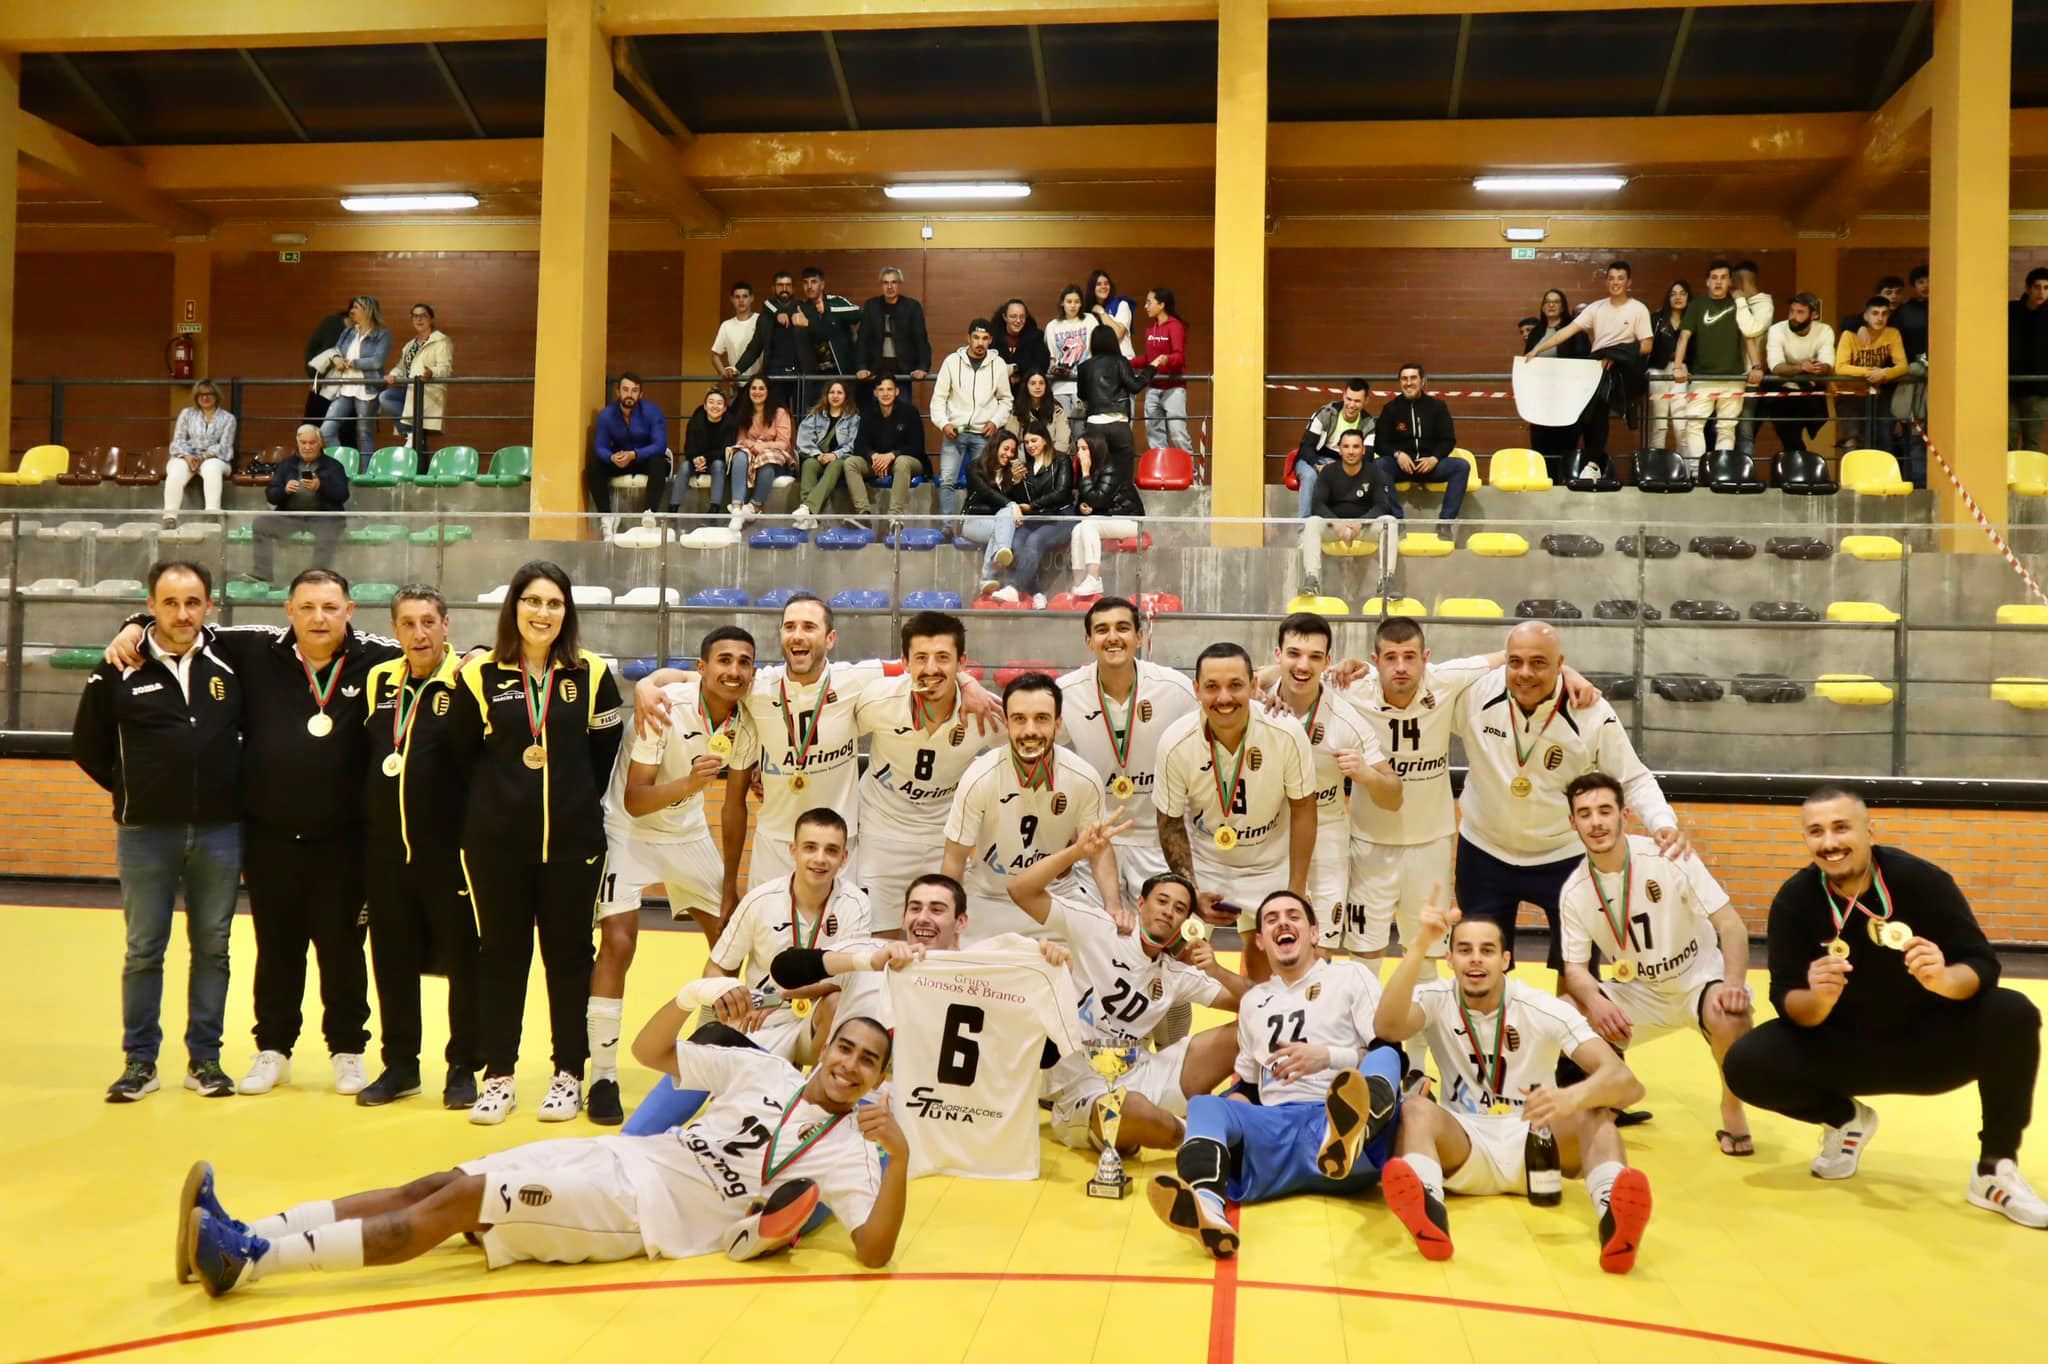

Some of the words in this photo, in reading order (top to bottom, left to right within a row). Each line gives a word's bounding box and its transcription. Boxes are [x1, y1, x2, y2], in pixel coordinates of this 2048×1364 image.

[1388, 718, 1421, 752] 14
[914, 748, 936, 781] 8
[1020, 815, 1038, 849] 9
[1346, 903, 1366, 935] 14
[1628, 912, 1654, 953] 17
[1637, 939, 1698, 979] Agrimog
[954, 974, 990, 988] Grupo
[967, 984, 979, 996] &
[983, 987, 1026, 1004] Branco
[937, 1003, 985, 1087] 6
[1268, 1009, 1308, 1053] 22
[723, 1116, 772, 1158] 12
